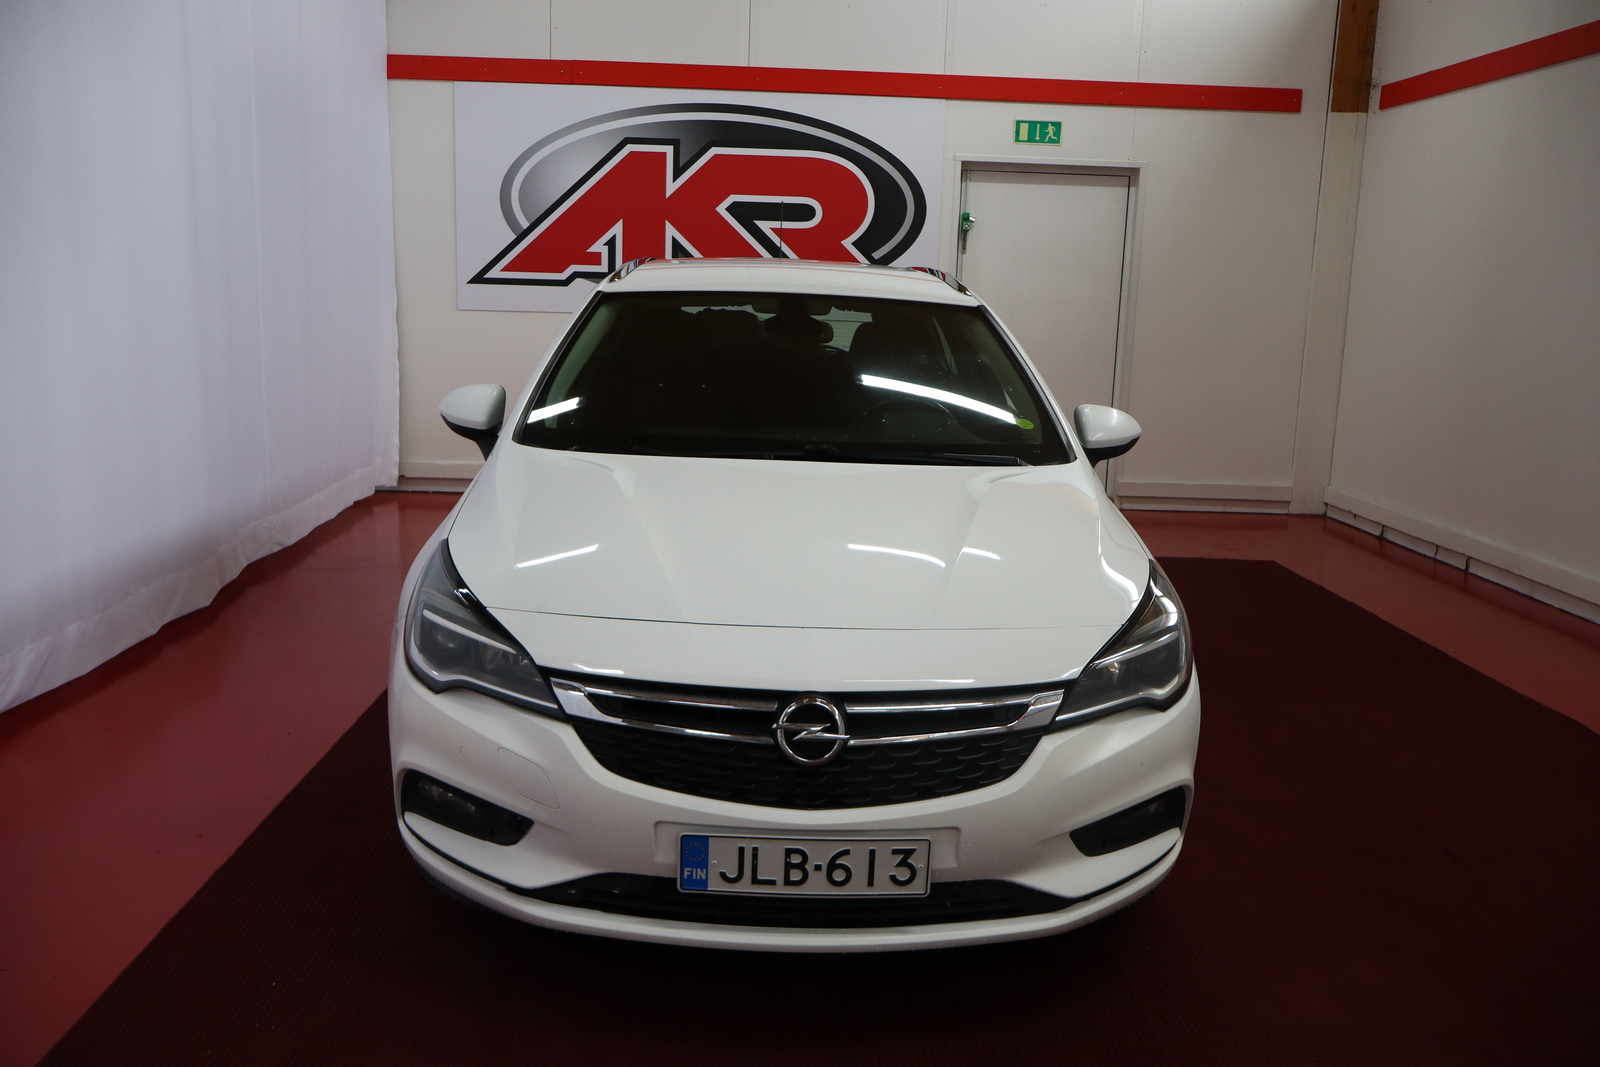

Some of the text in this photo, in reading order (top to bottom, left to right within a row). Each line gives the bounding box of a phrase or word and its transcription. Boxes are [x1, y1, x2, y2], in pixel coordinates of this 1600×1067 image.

[474, 140, 876, 283] AKR
[683, 867, 706, 880] FIN
[719, 845, 918, 888] JLB-613
